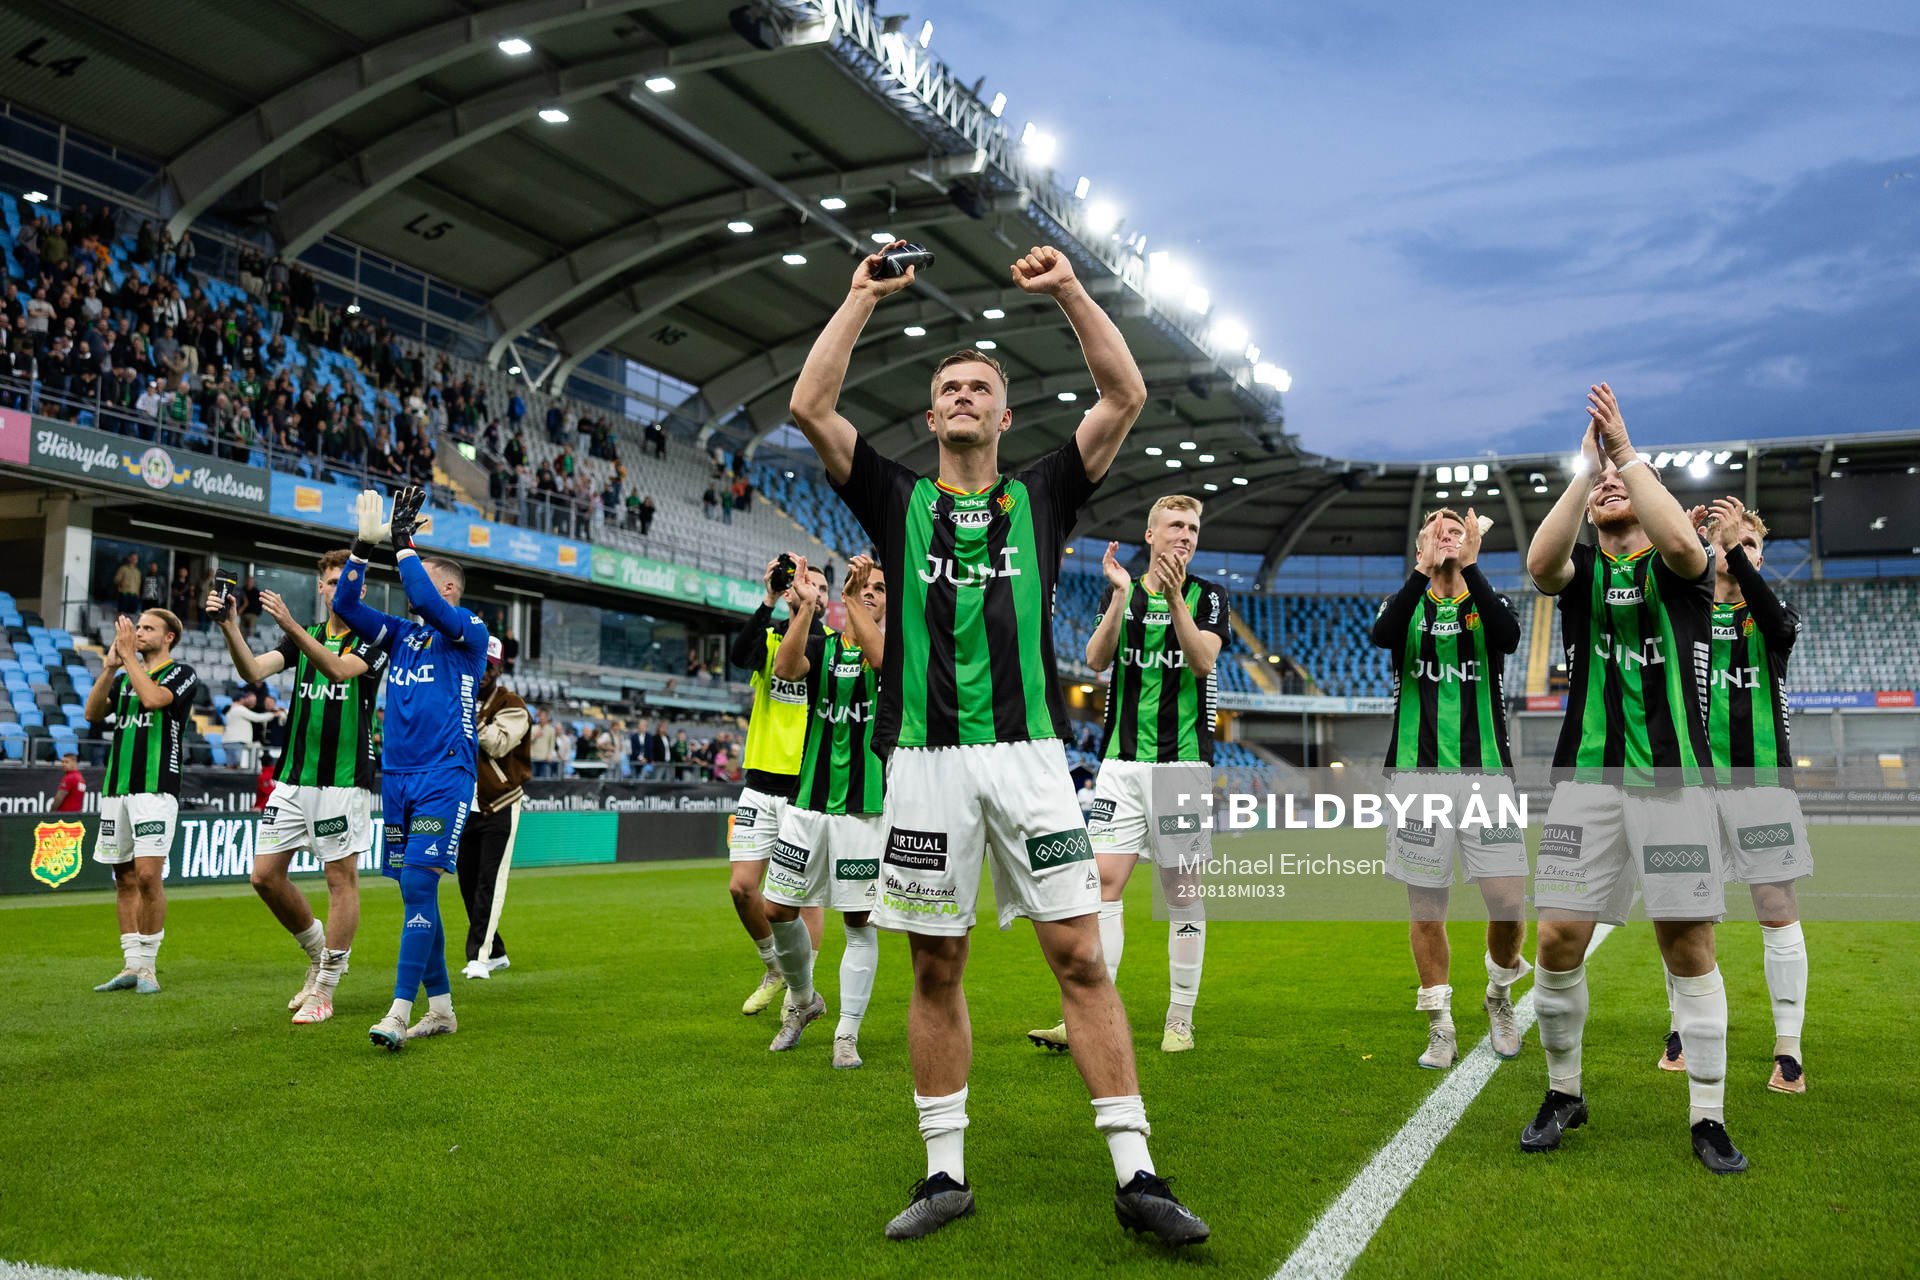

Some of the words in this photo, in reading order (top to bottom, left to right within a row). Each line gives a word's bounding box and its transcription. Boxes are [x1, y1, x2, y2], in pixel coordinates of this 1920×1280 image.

[403, 212, 455, 240] L5
[36, 430, 119, 473] Härryda
[192, 467, 264, 502] Karlsson
[958, 499, 986, 507] JUNI
[951, 512, 991, 523] SKAB
[918, 547, 1021, 589] JUNI
[1608, 588, 1640, 600] SKAB
[1433, 622, 1460, 631] SKAB
[1713, 627, 1735, 636] KAB
[1119, 647, 1188, 669] JUNI
[1594, 633, 1665, 671] JUNI
[836, 664, 860, 673] SKAB
[1410, 658, 1481, 682] JUNI
[298, 682, 350, 700] JUNI
[816, 698, 874, 724] JUNI
[1404, 821, 1433, 835] RTUAL
[1543, 828, 1577, 842] RTUAL
[1744, 828, 1789, 845] AVIX
[892, 833, 942, 851] VIRTUAL
[1035, 835, 1088, 862] AVIX
[775, 841, 806, 861] VIRTUAL
[889, 852, 939, 867] manufacturing
[1650, 851, 1704, 868] AVIX
[1543, 865, 1588, 879] Ekstrand
[905, 881, 957, 897] Ekstrand
